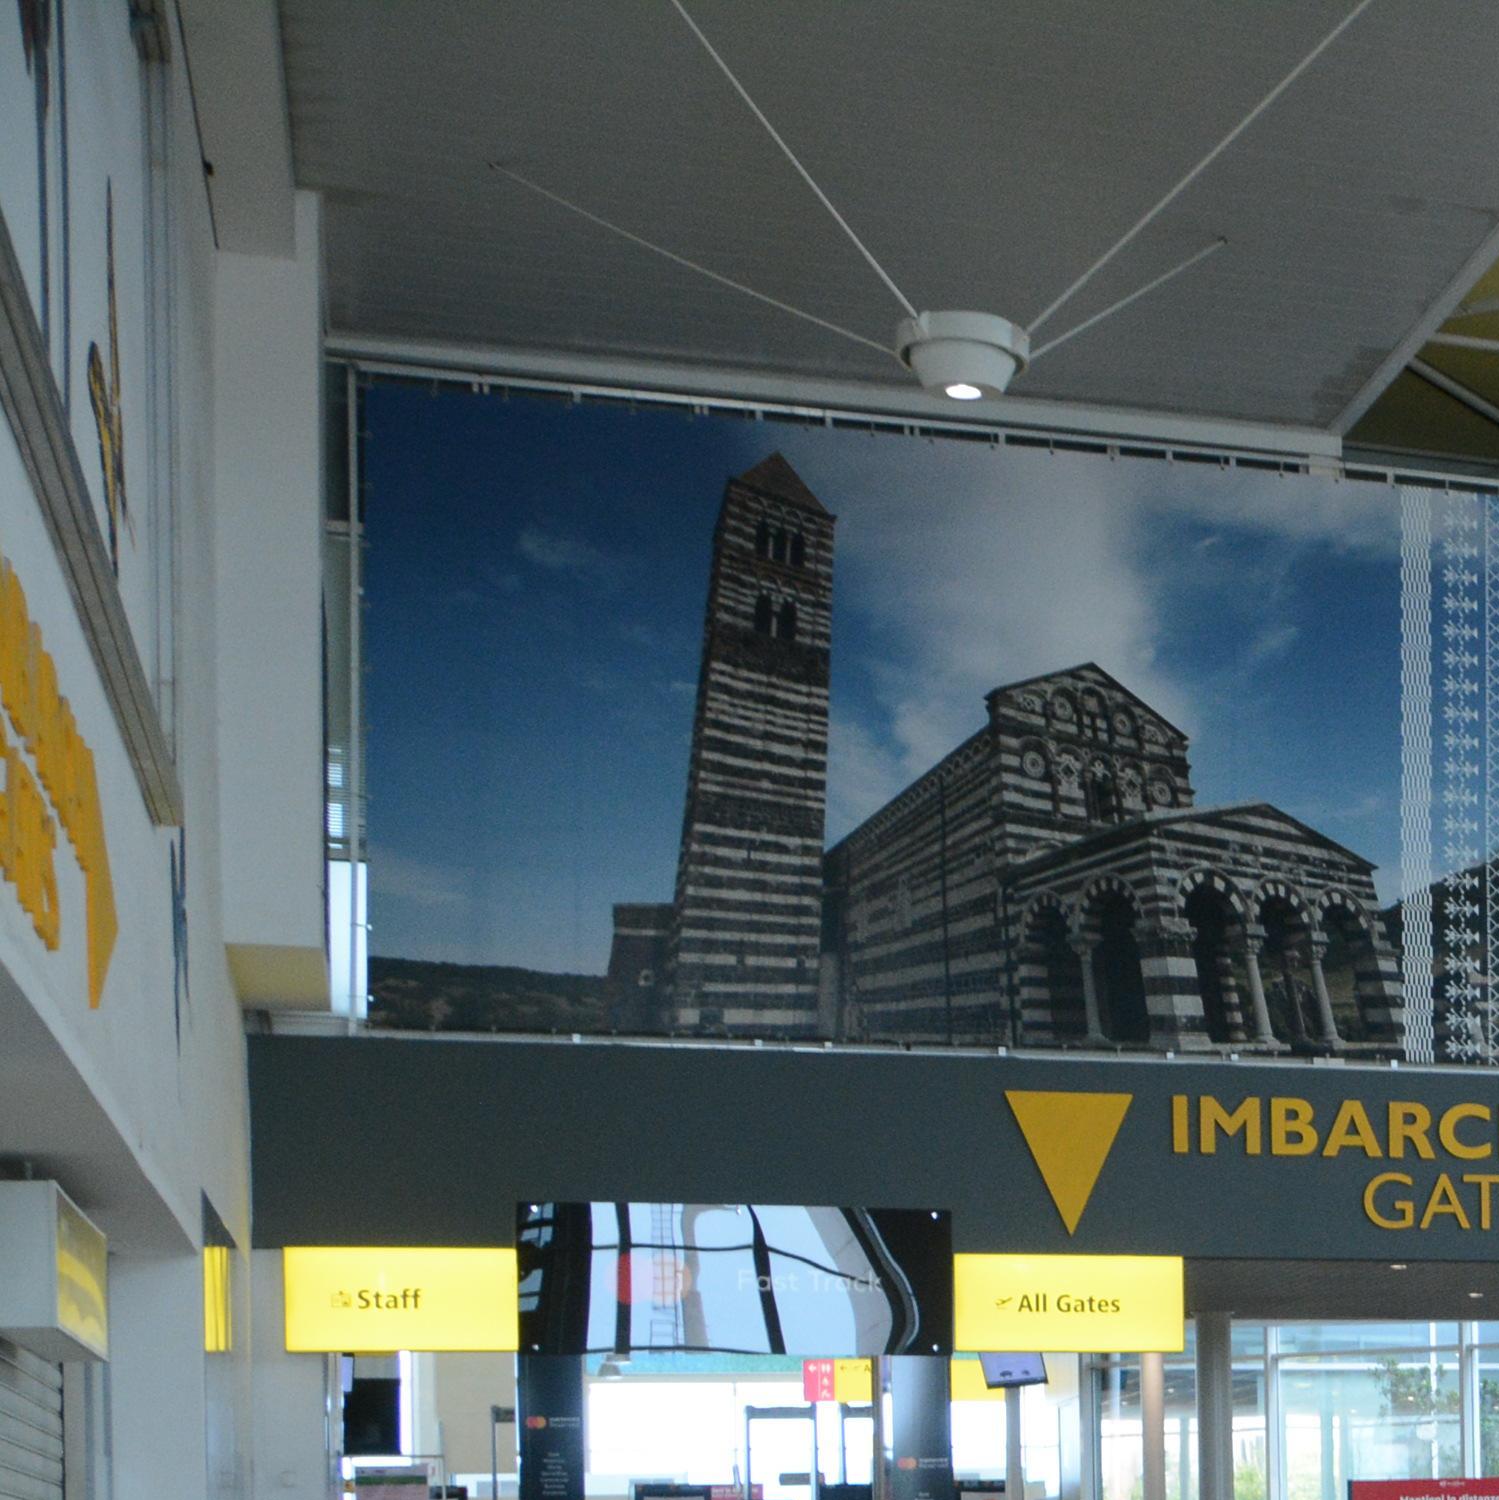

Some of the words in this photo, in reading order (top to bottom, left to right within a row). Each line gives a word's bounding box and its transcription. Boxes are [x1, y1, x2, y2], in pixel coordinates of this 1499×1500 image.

[737, 1269, 798, 1293] Fast
[809, 1269, 883, 1294] Track
[357, 1287, 422, 1310] Staff
[1018, 1293, 1048, 1313] All
[1055, 1294, 1121, 1314] Gates
